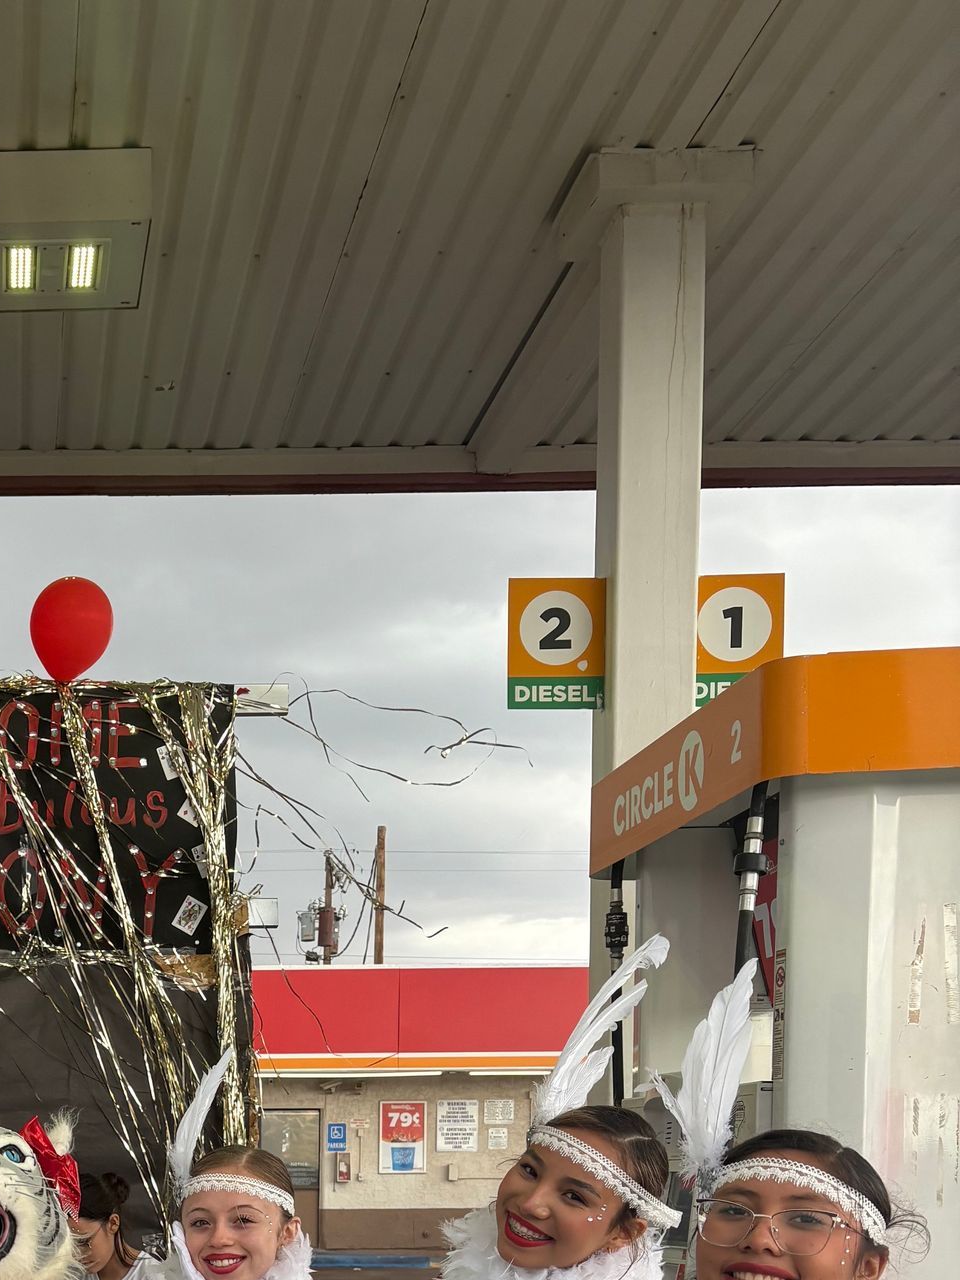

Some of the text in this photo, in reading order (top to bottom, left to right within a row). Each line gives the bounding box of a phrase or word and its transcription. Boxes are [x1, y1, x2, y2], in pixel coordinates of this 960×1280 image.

[539, 607, 572, 650] 2
[722, 606, 744, 649] 1
[514, 685, 596, 703] DIESEL
[729, 719, 742, 764] 2
[613, 730, 704, 836] CIRCLE K
